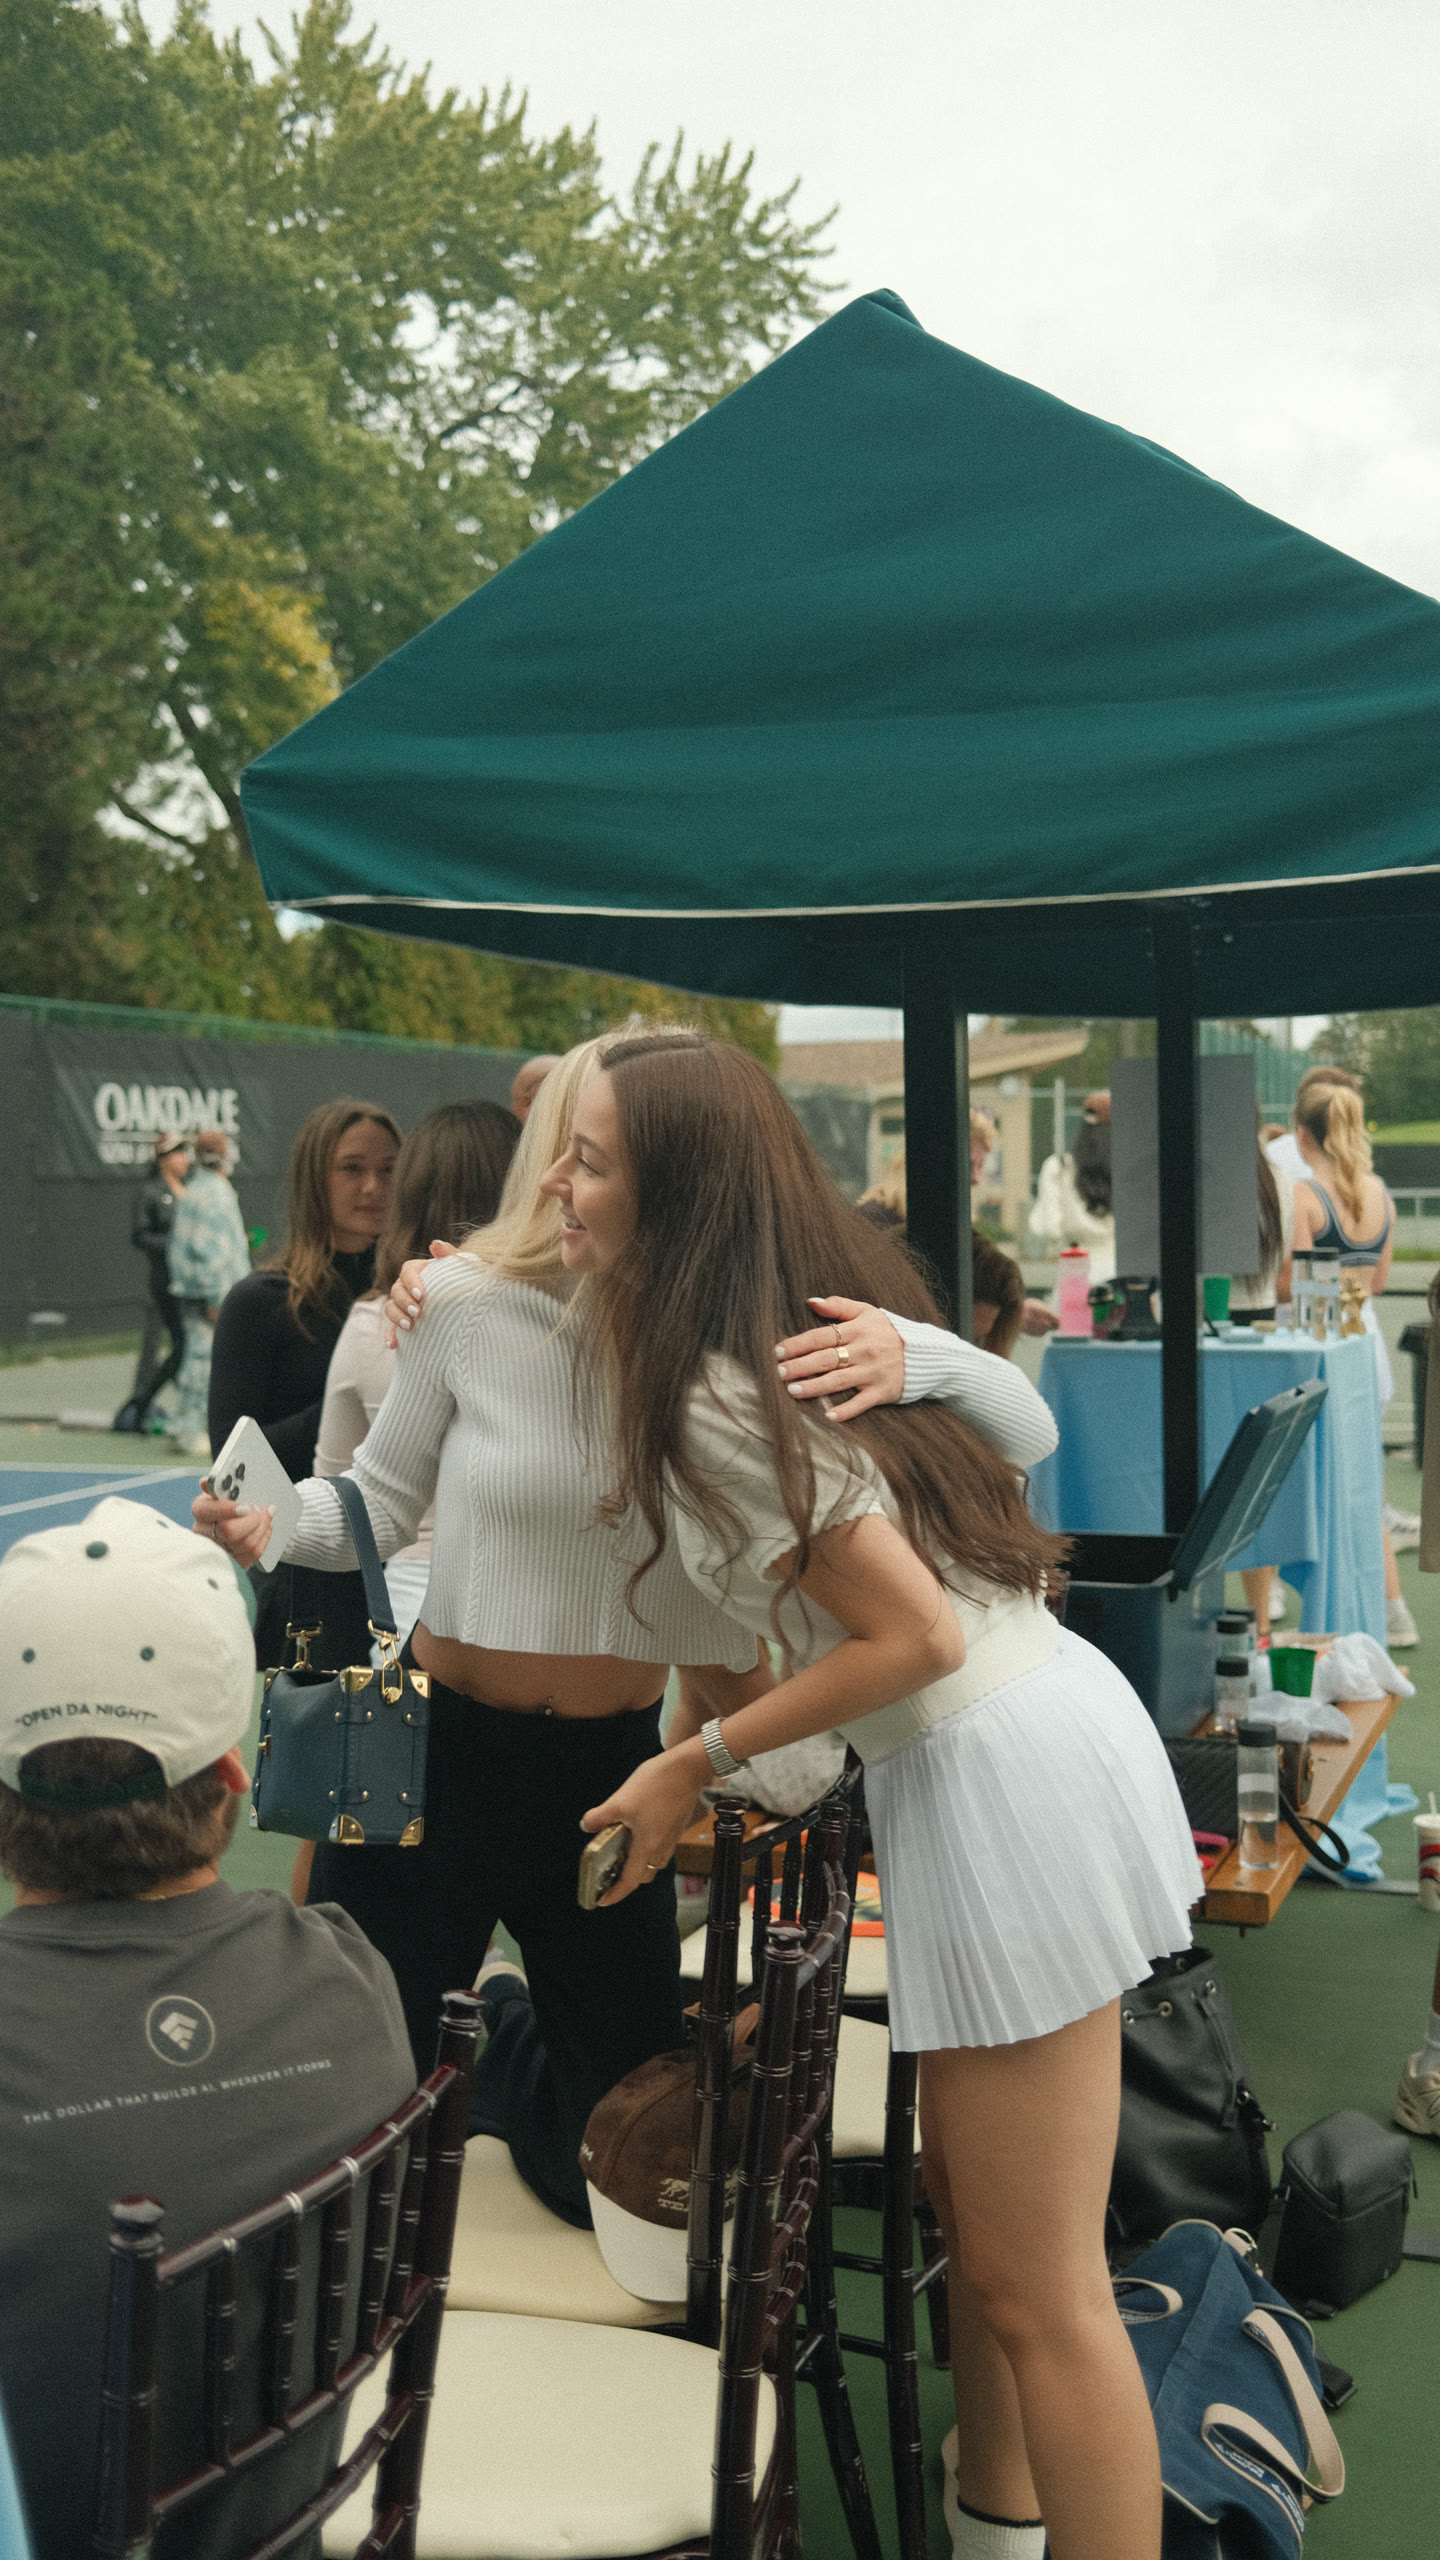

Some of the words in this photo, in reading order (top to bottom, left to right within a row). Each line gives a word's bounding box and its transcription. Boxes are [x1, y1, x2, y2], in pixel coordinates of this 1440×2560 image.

[94, 1082, 241, 1135] OAKDALE
[66, 1702, 90, 1716] DA
[23, 2110, 50, 2125] THE
[56, 2099, 112, 2118] DOLLAR
[116, 2092, 148, 2107] THAT
[152, 2086, 198, 2101] BUILDS
[220, 2069, 280, 2090] WHEREVER
[283, 2066, 294, 2077] IT
[296, 2058, 332, 2073] FORMS
